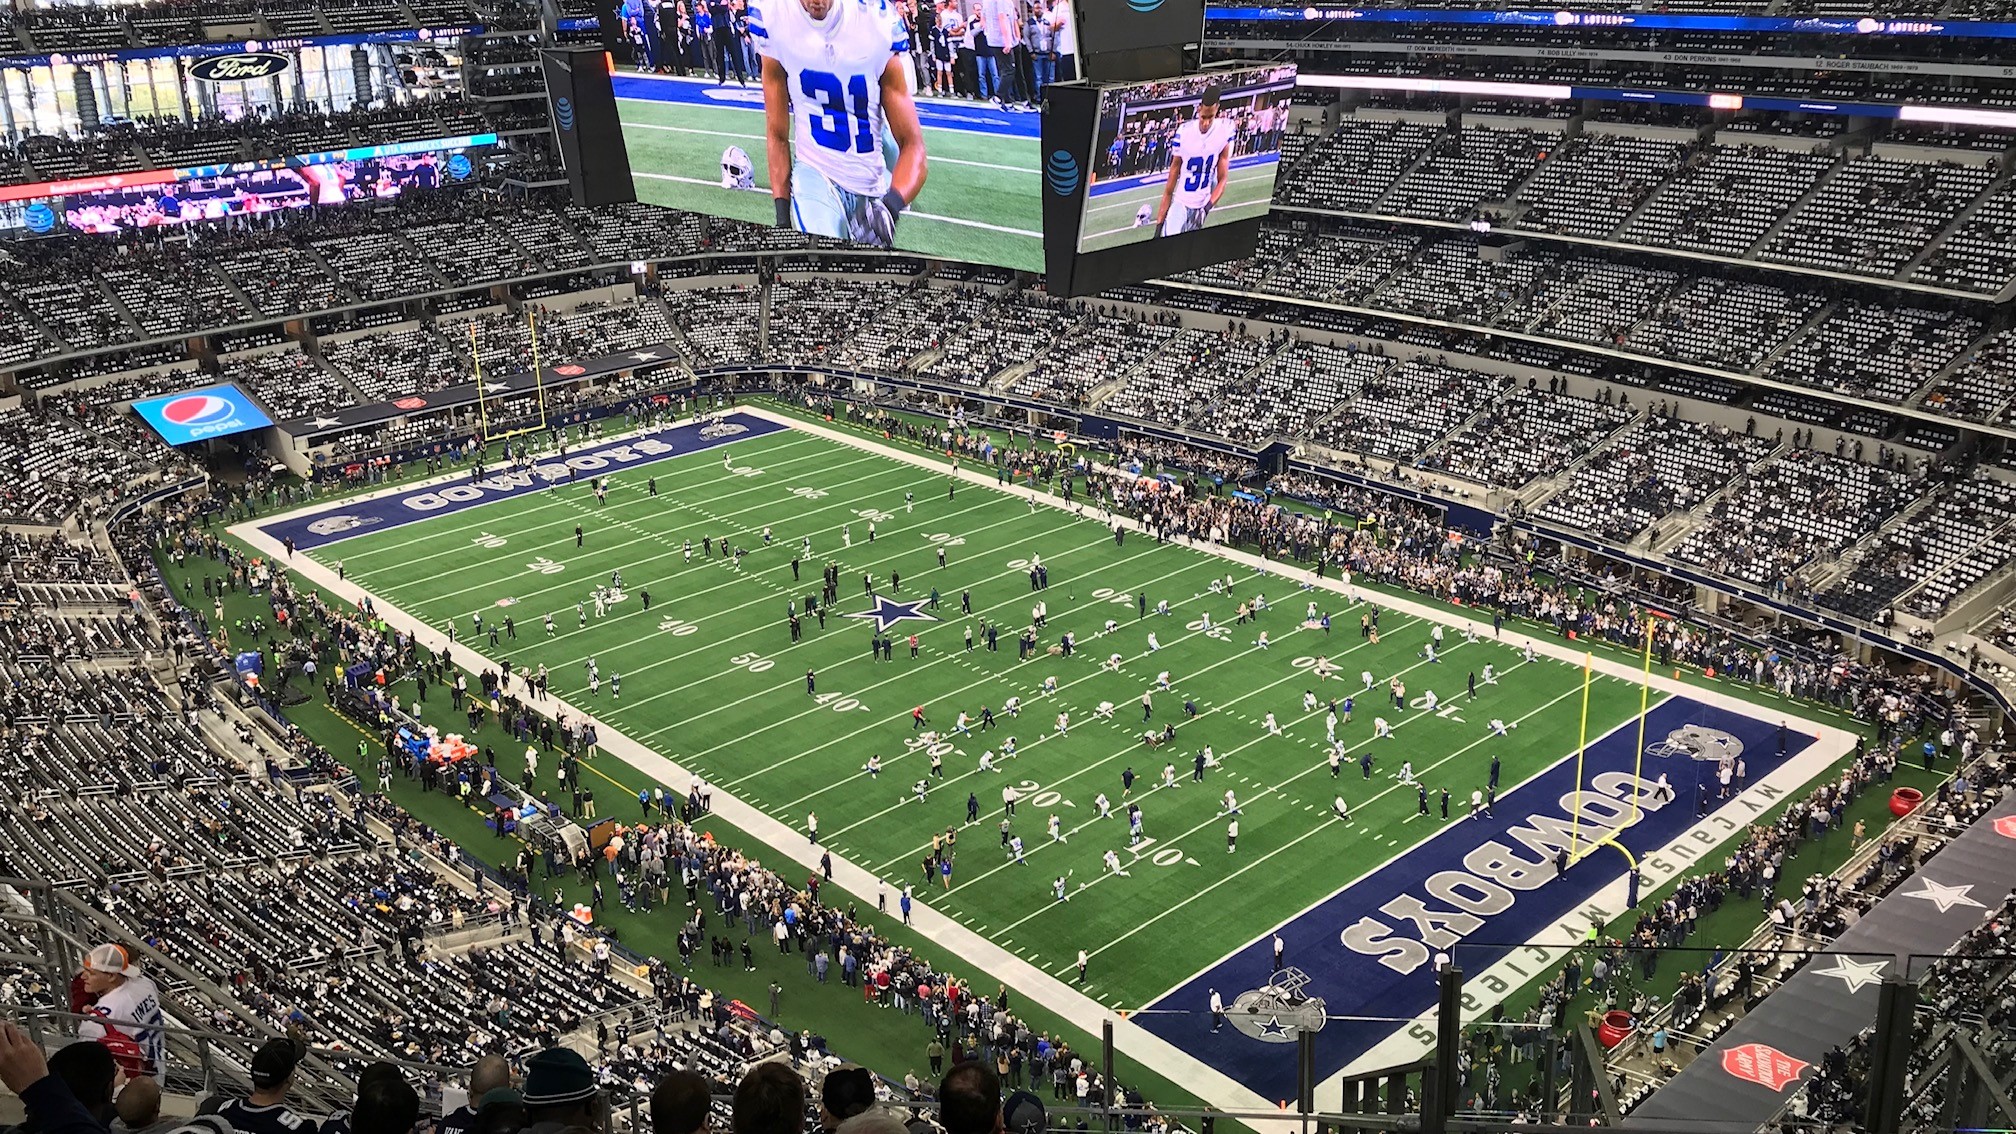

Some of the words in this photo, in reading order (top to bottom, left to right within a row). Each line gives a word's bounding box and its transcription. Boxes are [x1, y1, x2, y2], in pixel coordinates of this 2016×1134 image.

[209, 57, 272, 79] Ford
[1852, 62, 1889, 70] STAUBACH
[799, 68, 874, 153] 31
[1184, 154, 1214, 192] 31
[189, 418, 246, 438] pepsi
[402, 438, 673, 511] COWBOYS
[731, 466, 758, 478] 10
[793, 486, 829, 499] 20
[858, 508, 895, 522] 30
[471, 533, 507, 548] 10
[929, 532, 966, 546] 40
[526, 559, 565, 575] 20
[1092, 588, 1134, 603] 40
[658, 620, 698, 637] 40
[1186, 620, 1232, 639] 30
[730, 651, 775, 673] 50
[814, 691, 859, 712] 40
[1740, 783, 1784, 812] MY
[1123, 836, 1183, 866] 10
[1341, 771, 1676, 975] COWBOYS
[1559, 903, 1612, 940] MY
[1735, 1049, 1756, 1077] ARMY
[1754, 1045, 1777, 1087] SALVATION
[1775, 1058, 1792, 1078] THE
